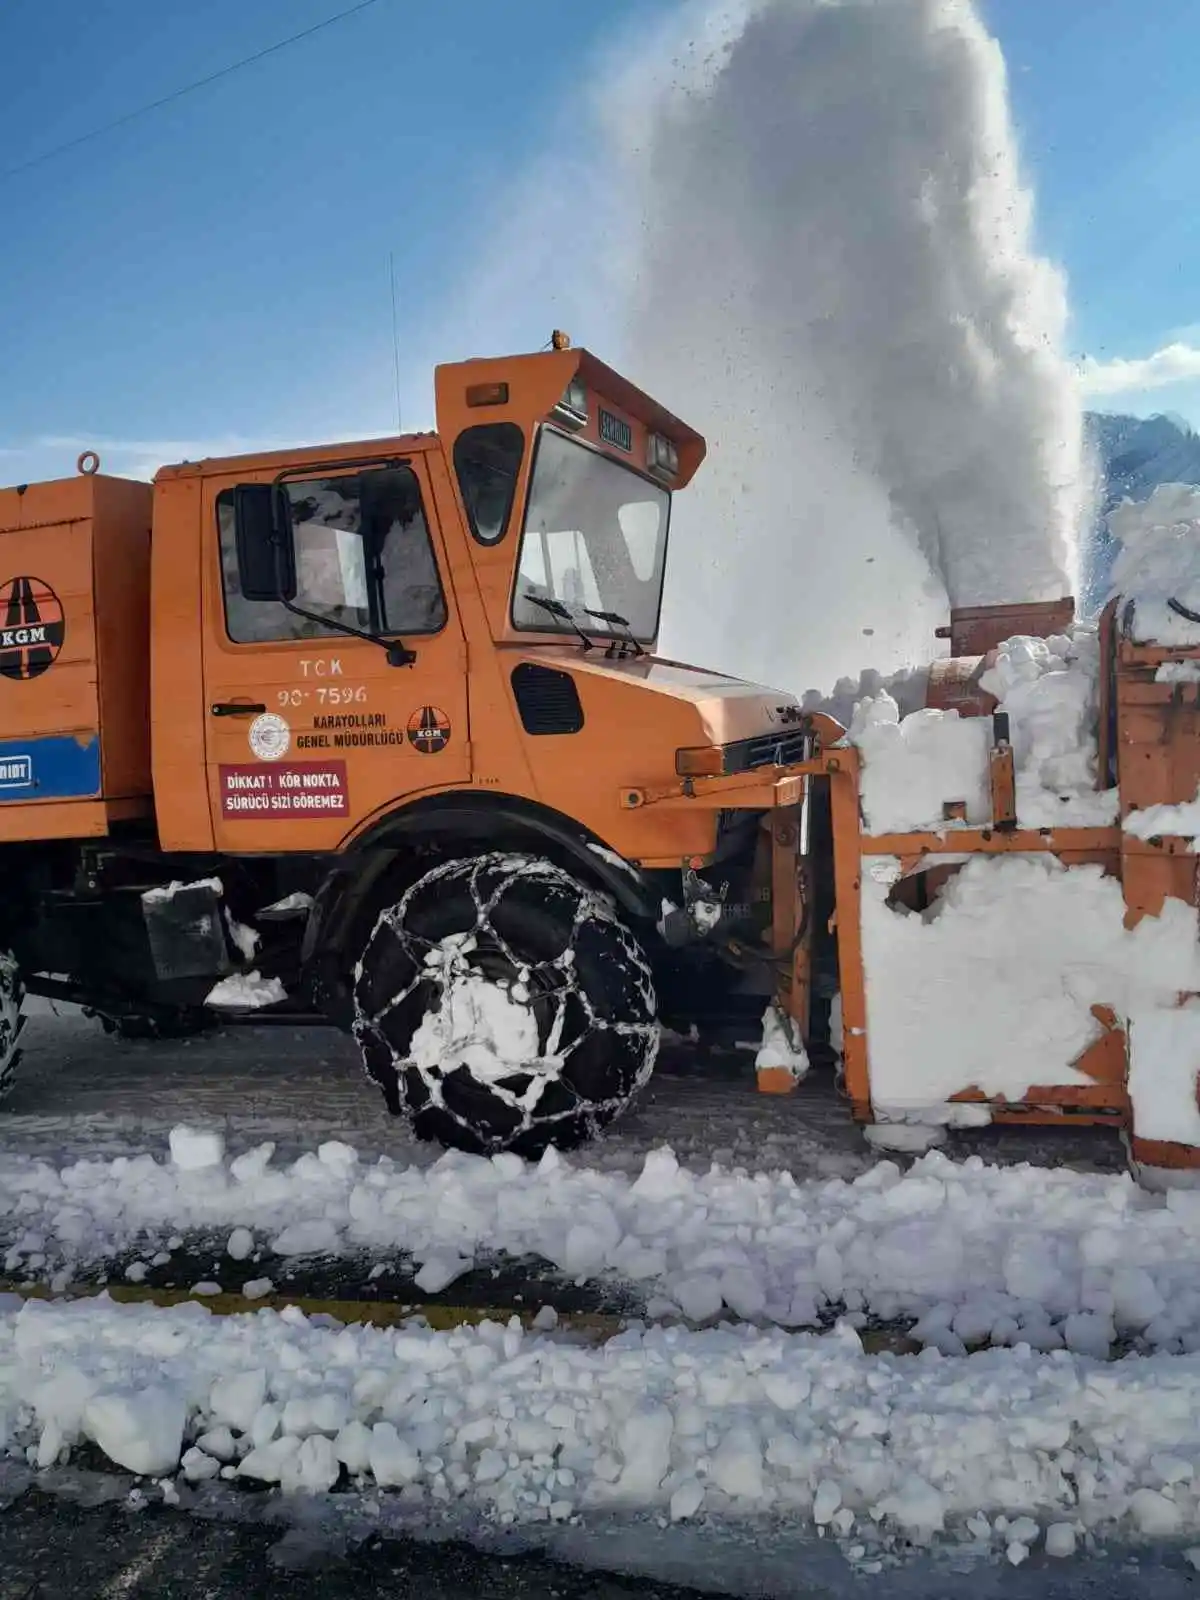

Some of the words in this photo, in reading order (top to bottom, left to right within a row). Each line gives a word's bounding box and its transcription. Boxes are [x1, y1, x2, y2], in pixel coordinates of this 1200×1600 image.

[2, 627, 46, 646] KGM
[299, 658, 343, 678] TCK
[313, 713, 386, 729] KARAYOLLARI
[296, 734, 331, 749] GENEL
[333, 728, 404, 748] MÜDÜRLÜĞÜ
[416, 729, 441, 737] KGM
[279, 771, 301, 788] KÖR
[303, 773, 340, 788] NOKTA
[226, 793, 269, 810] SÜRÜCÜ
[271, 793, 291, 809] SİZİ
[293, 792, 344, 808] GÖREMEZ
